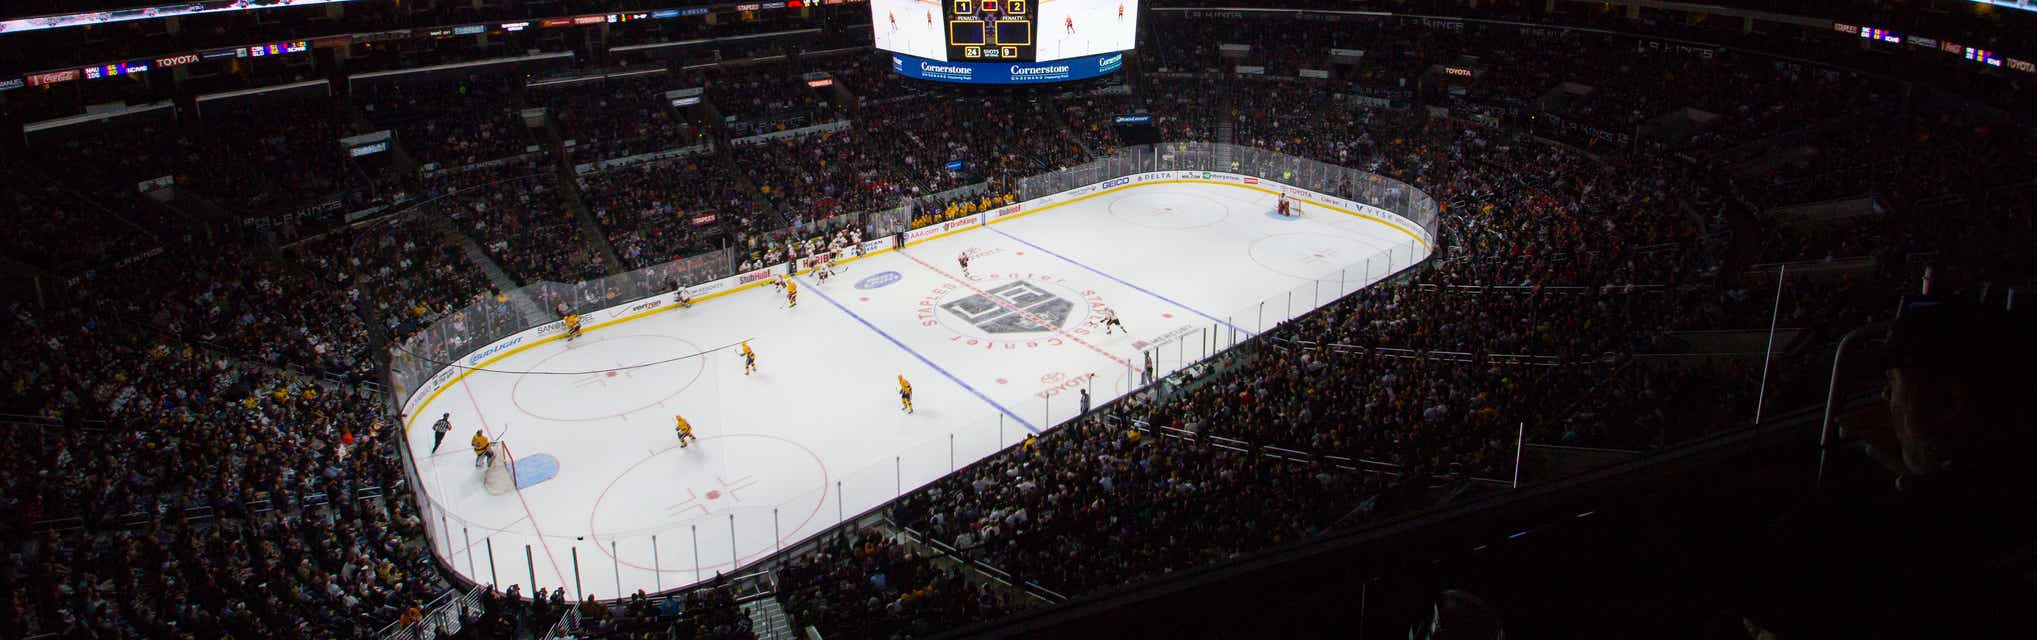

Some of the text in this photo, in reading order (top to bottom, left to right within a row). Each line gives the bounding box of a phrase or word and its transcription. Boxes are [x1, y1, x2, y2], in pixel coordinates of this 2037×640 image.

[1014, 2, 1021, 11] 2
[967, 48, 977, 56] 24
[157, 54, 200, 69] TOYOTA
[922, 61, 972, 74] Cornerstone
[1011, 64, 1069, 75] Cornerstone
[1445, 67, 1472, 77] TOYOTA
[1102, 177, 1130, 189] GEICO
[1144, 173, 1172, 181] DELTA
[910, 227, 940, 240] AAA.com
[633, 299, 662, 311] verizon
[917, 282, 958, 328] STAPLES
[469, 336, 523, 366] BUD LIGHT
